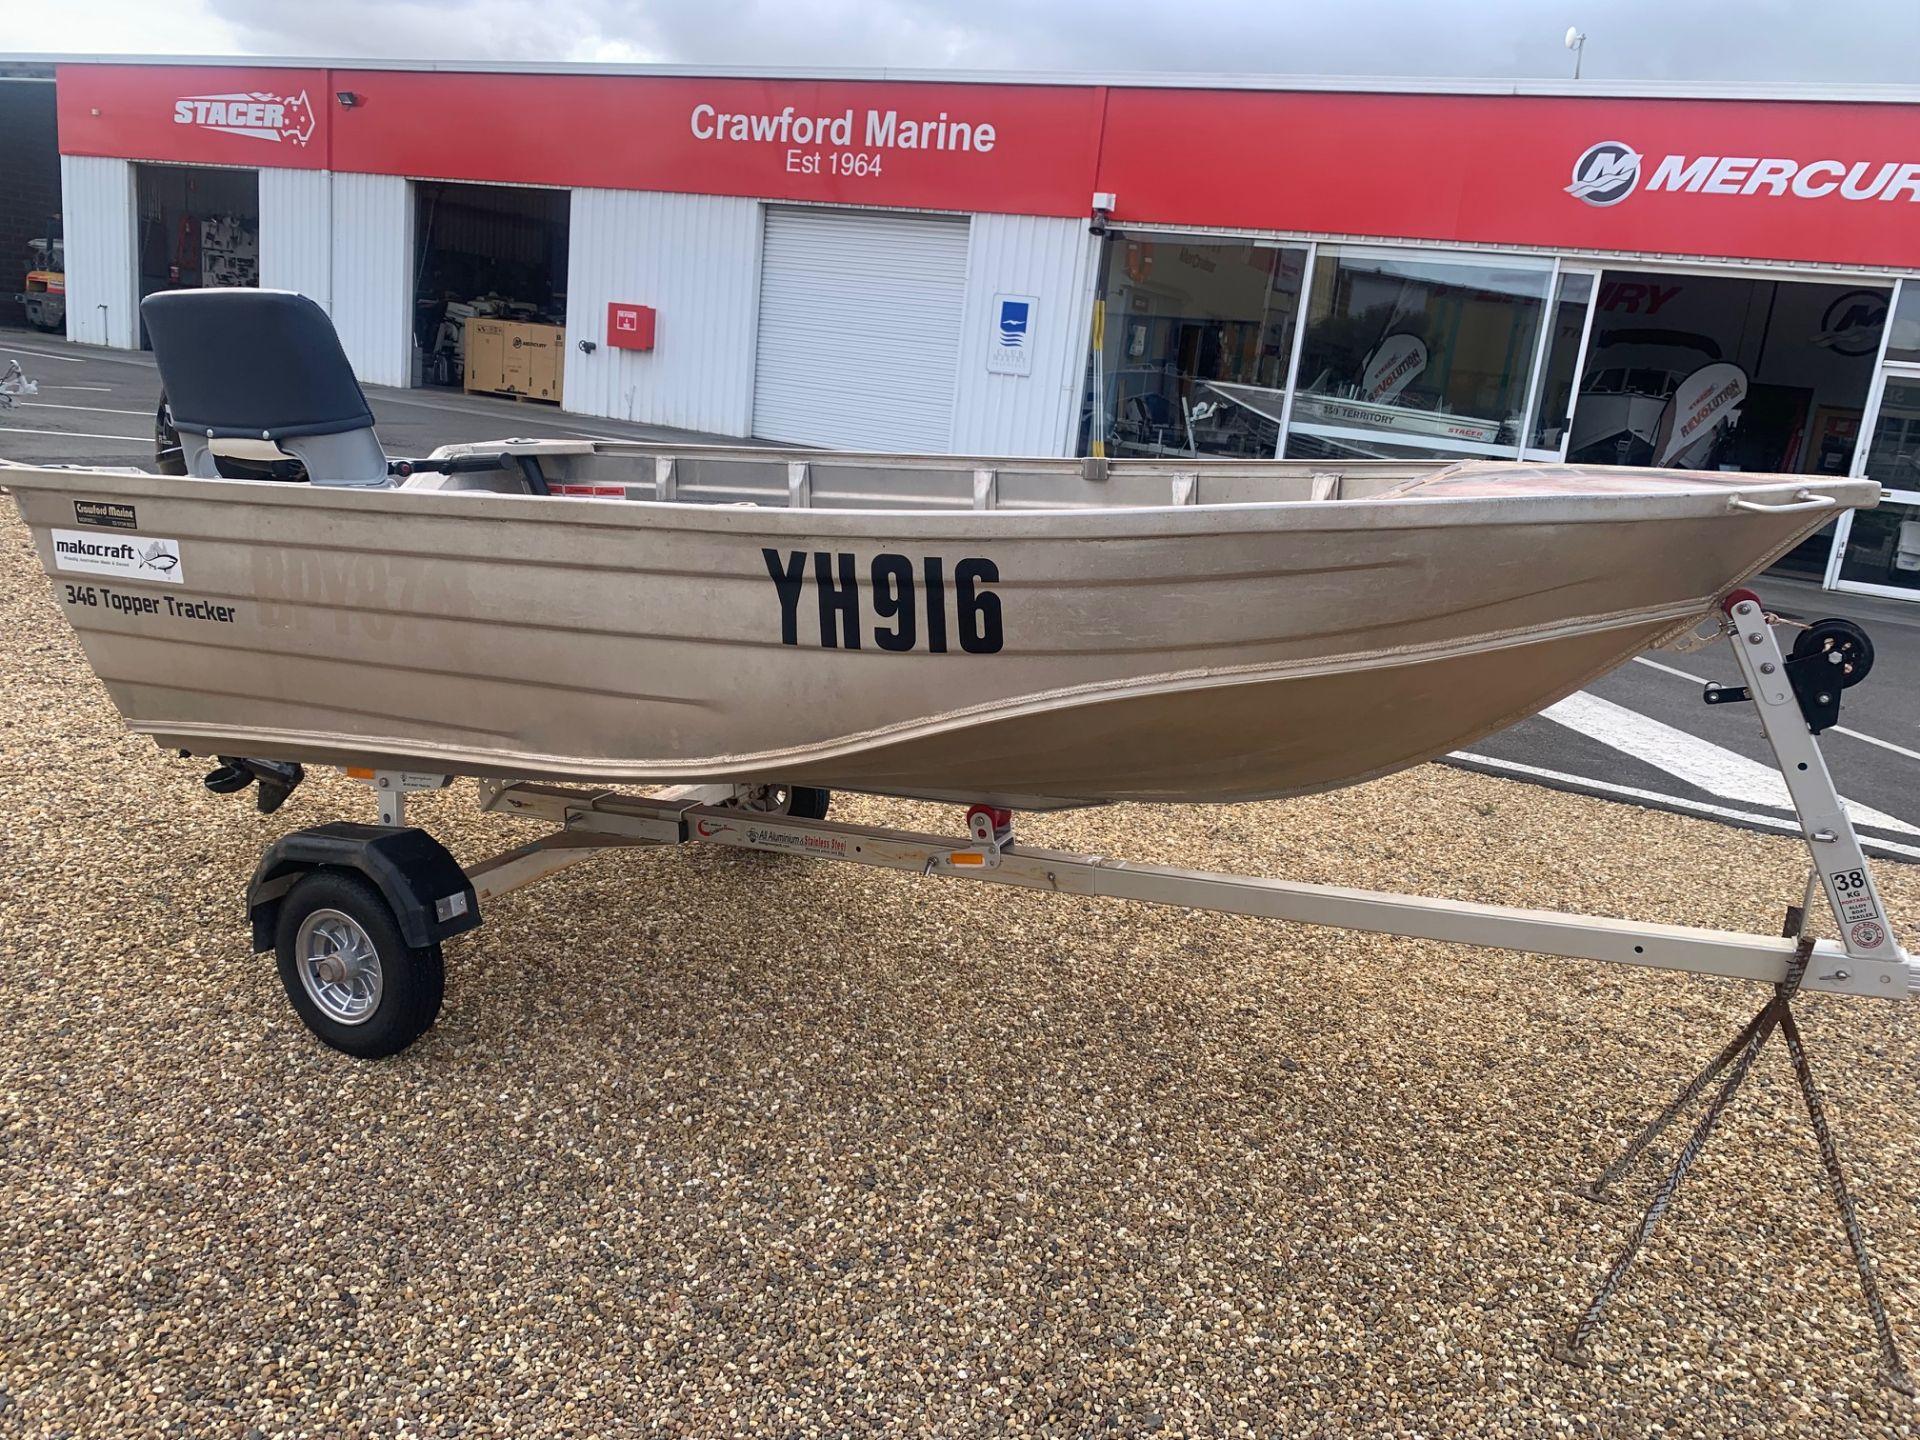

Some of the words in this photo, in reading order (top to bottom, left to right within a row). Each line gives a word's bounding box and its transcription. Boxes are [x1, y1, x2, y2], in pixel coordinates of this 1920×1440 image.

[174, 101, 285, 128] STACER
[690, 104, 853, 146] Crawford
[864, 110, 996, 153] Marine
[786, 150, 821, 174] Est
[829, 153, 882, 177] 1964
[1645, 155, 1920, 202] MERCUR
[1342, 408, 1395, 424] TERRITORY
[1680, 379, 1740, 437] REVOLUTION
[77, 503, 107, 516] Crawford
[108, 506, 134, 519] Marine
[56, 539, 135, 560] makocraft
[65, 585, 97, 606] 346
[100, 589, 160, 615] Topper
[164, 596, 236, 622] Tracker
[761, 548, 1003, 654] YH916
[805, 835, 830, 848] Stainless
[832, 838, 847, 851] Steel
[1834, 871, 1864, 891] 38
